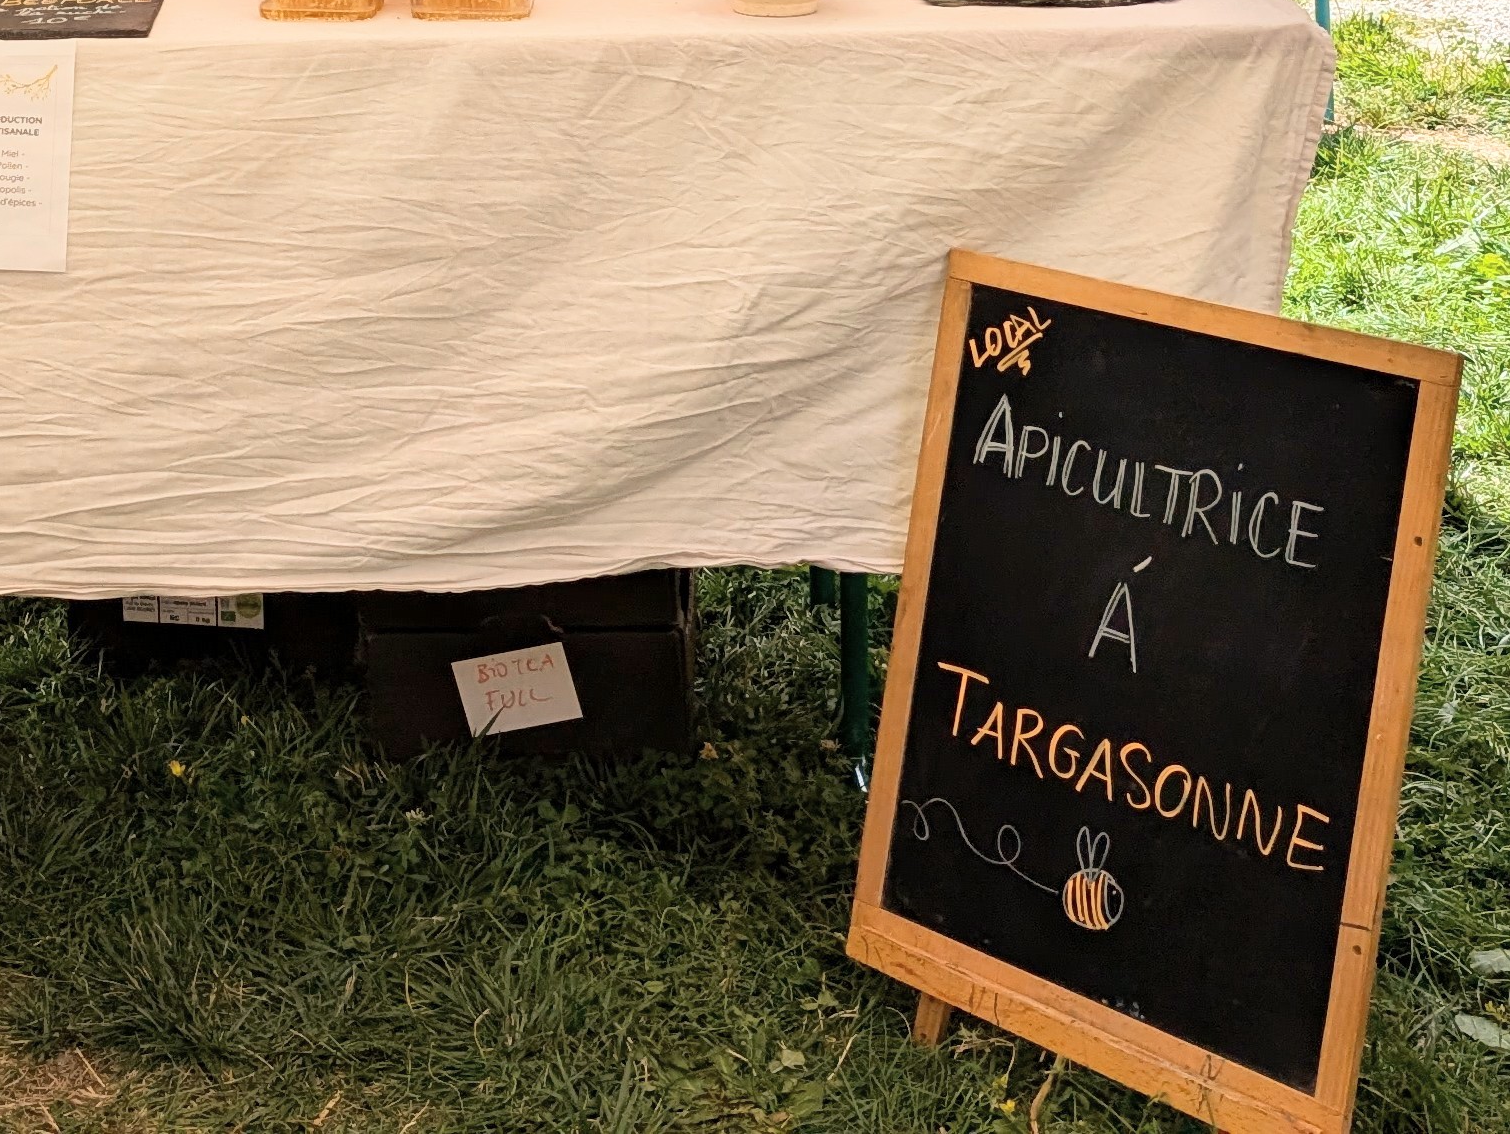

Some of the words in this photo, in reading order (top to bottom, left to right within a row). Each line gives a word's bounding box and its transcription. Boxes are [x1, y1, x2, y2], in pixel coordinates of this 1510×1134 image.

[0, 198, 36, 207] d'épices
[969, 306, 1051, 368] LOCAL
[485, 689, 554, 712] FULL
[937, 661, 1329, 870] TARGASONNE
